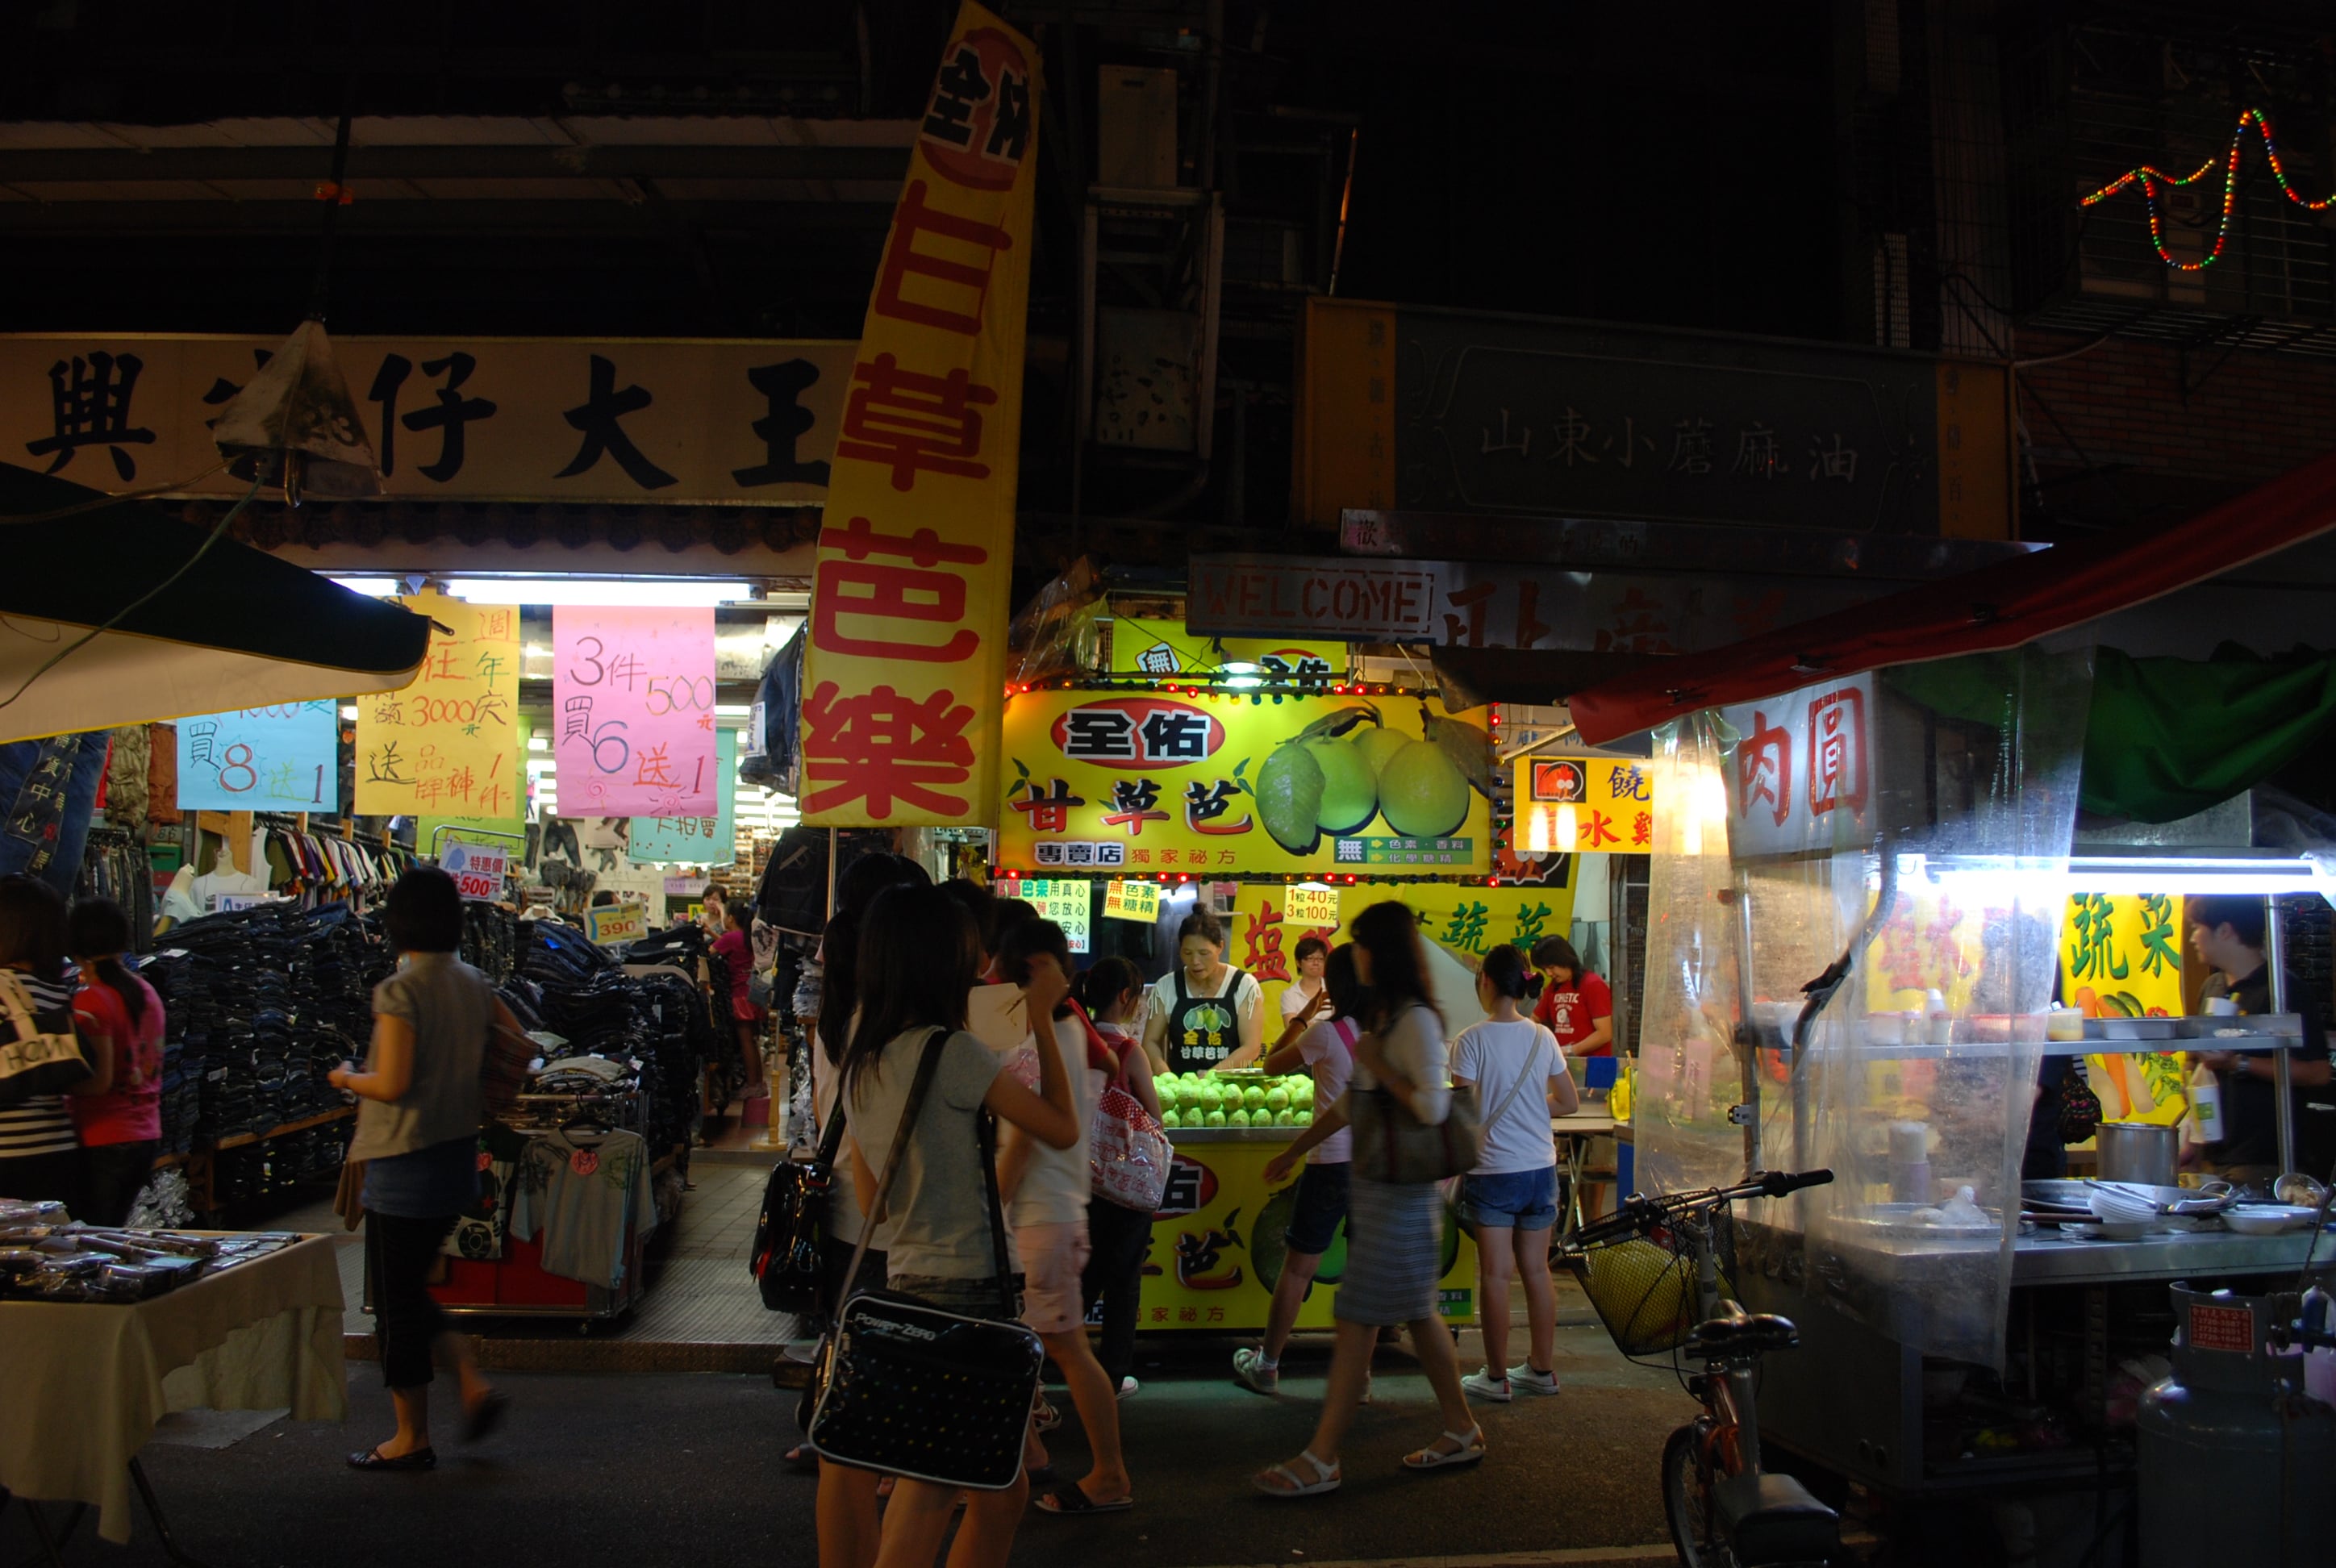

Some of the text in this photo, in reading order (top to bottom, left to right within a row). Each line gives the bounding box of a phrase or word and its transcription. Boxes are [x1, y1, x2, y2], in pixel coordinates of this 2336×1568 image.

[26, 349, 832, 490] 興仔大王
[1201, 573, 1422, 623] WELCOME
[1062, 708, 1212, 761] 全佑
[1737, 686, 1870, 828] 肉圓
[1009, 778, 1255, 836] 甘草芭
[1034, 841, 1124, 866] 專賣店
[1337, 839, 1362, 861] 無
[1109, 881, 1156, 899] 無色素
[1106, 895, 1153, 914] 無糖精
[1287, 903, 1337, 920] 3粒100元
[599, 920, 636, 936] 390
